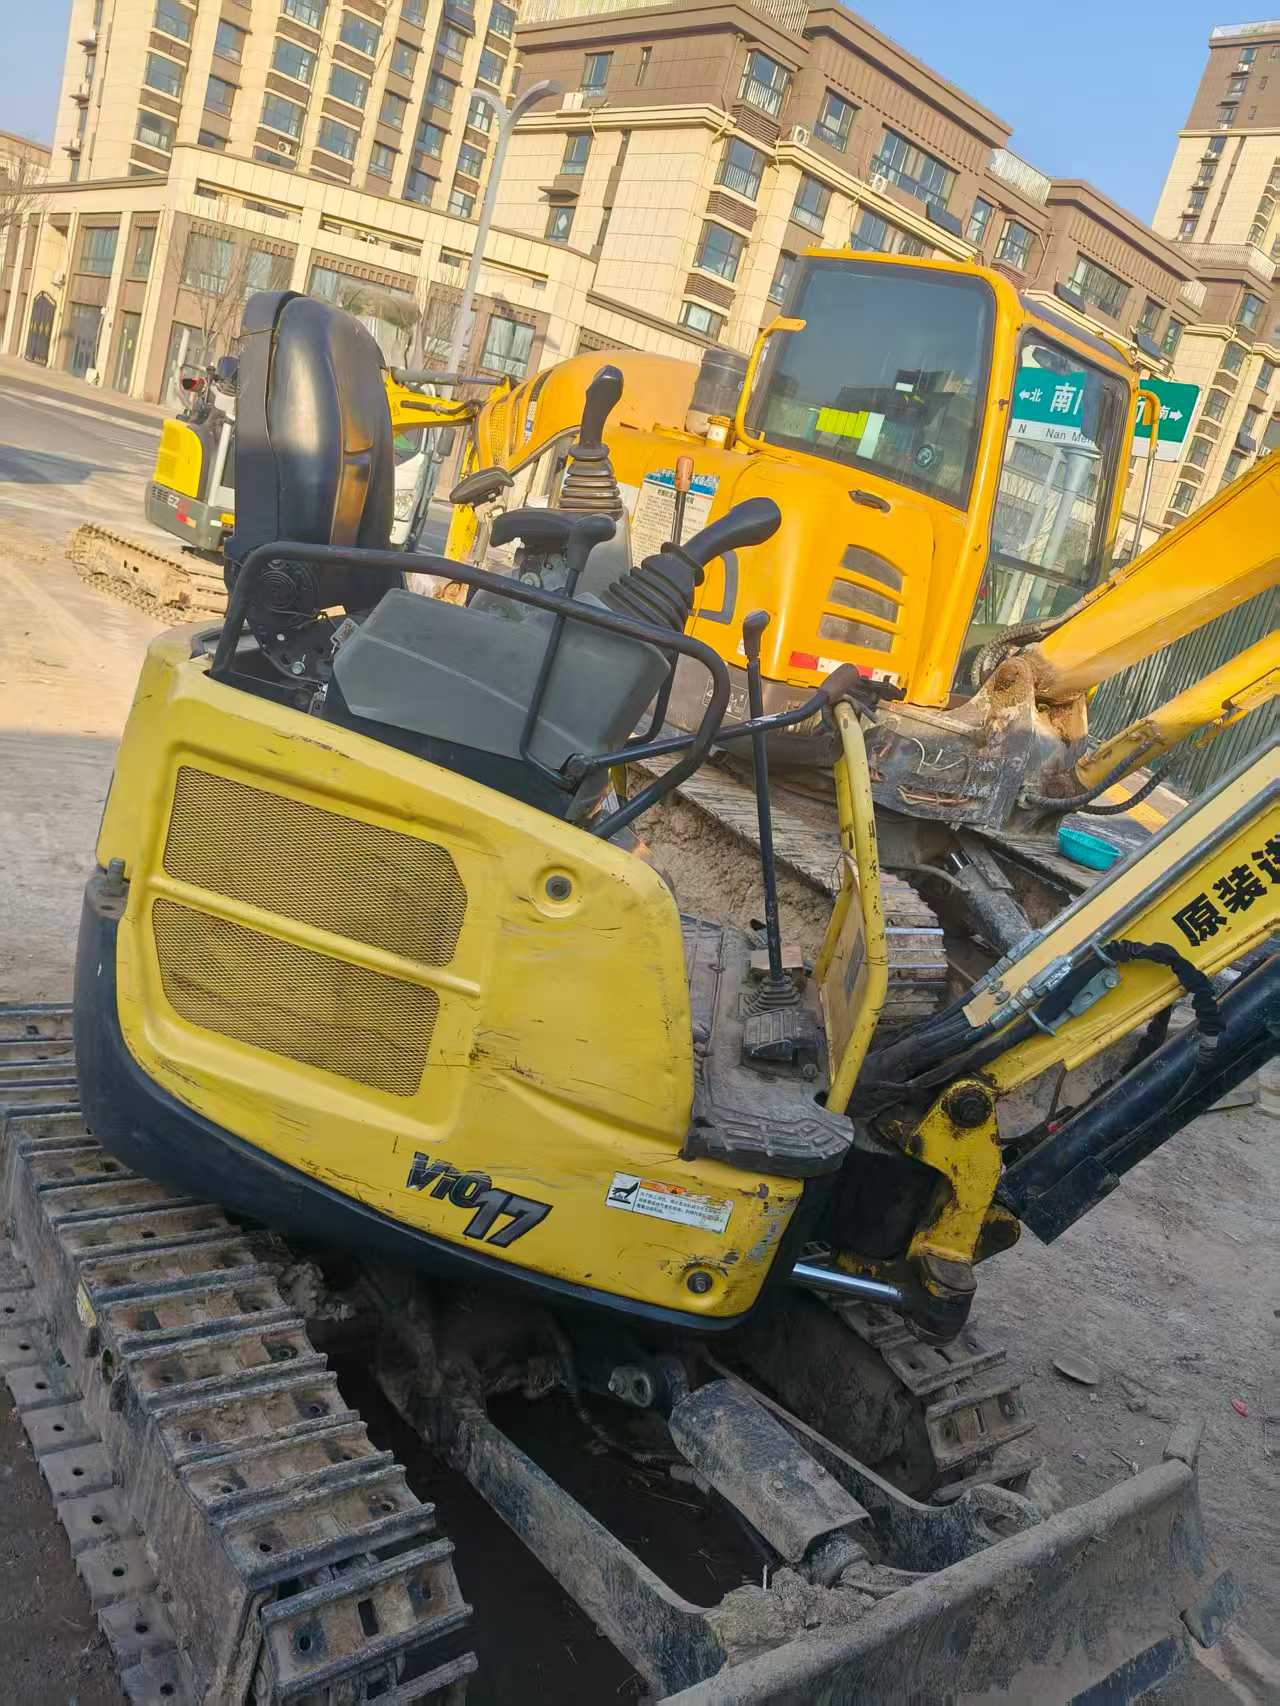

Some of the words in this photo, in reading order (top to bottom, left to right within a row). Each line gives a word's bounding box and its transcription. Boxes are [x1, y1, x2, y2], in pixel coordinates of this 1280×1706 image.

[1029, 387, 1043, 402] 北
[1018, 423, 1027, 434] N
[1045, 428, 1066, 441] Nan
